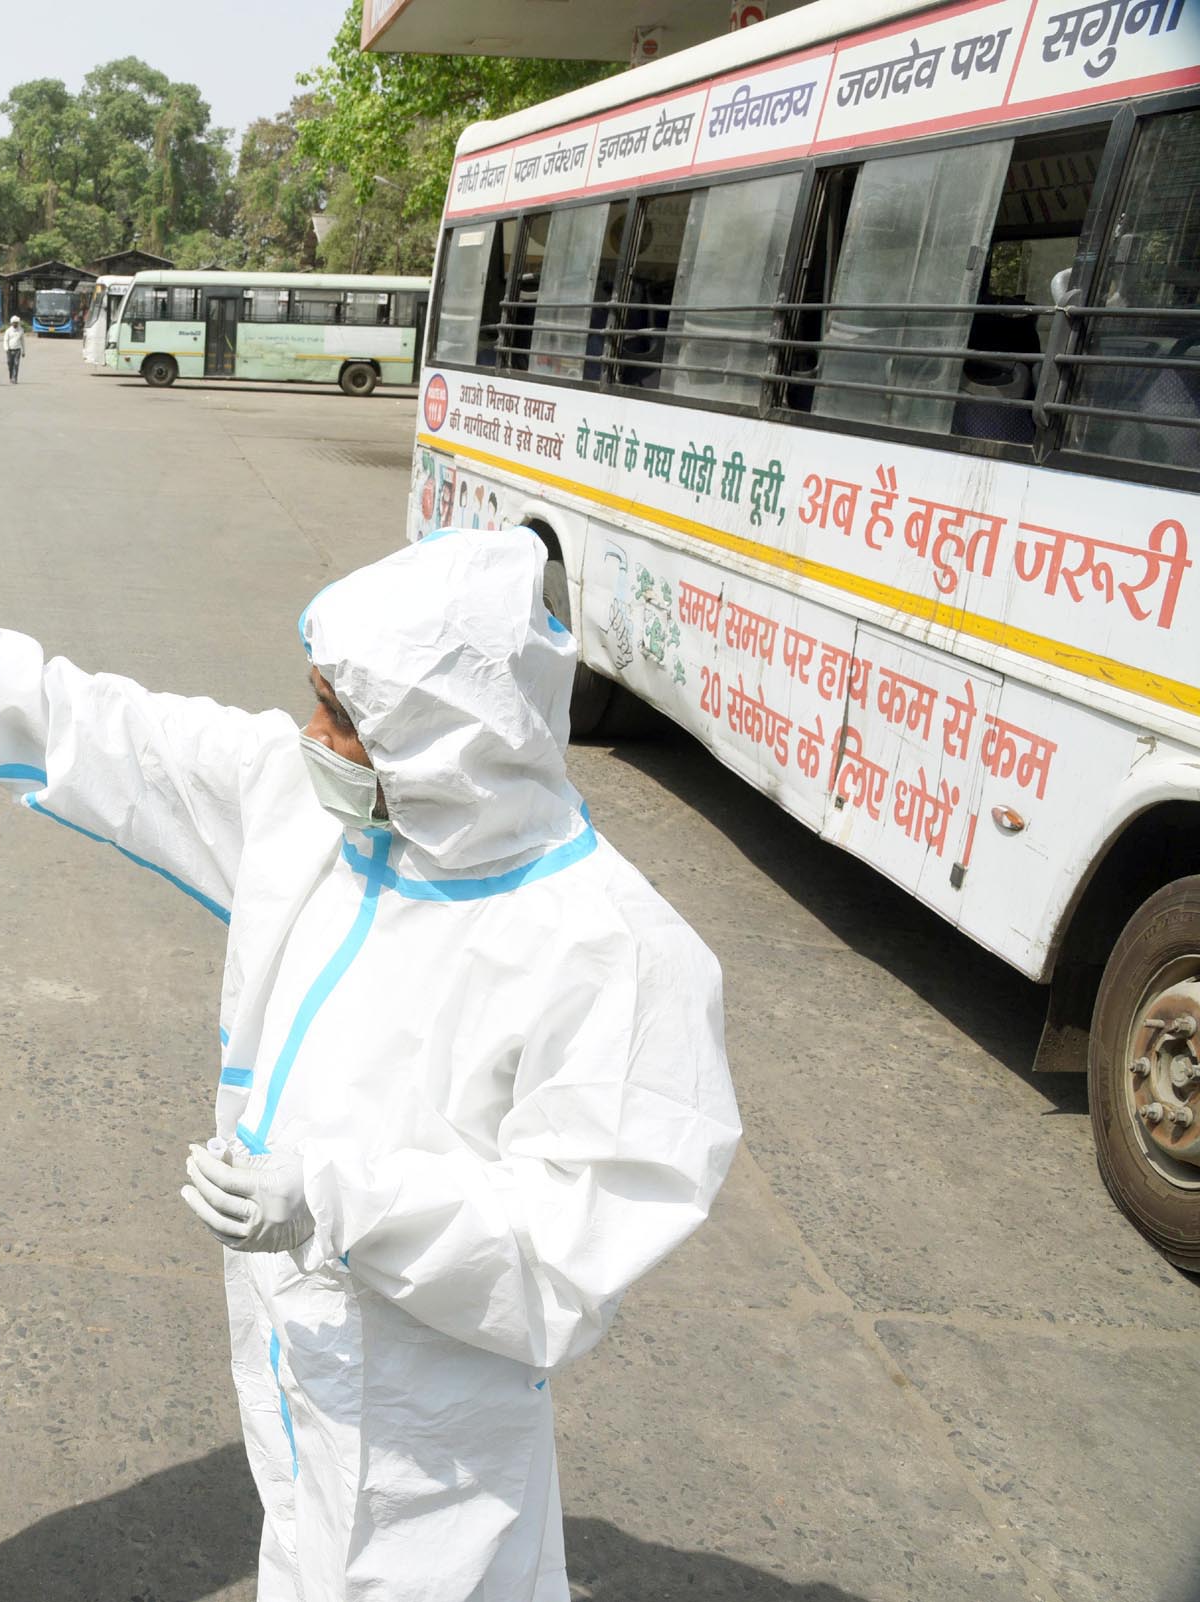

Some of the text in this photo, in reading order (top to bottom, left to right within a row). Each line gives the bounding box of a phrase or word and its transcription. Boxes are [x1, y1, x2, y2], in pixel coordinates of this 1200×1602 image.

[837, 27, 1011, 108] जगदेव पथ
[1043, 0, 1185, 78] सगुना
[597, 108, 696, 168] इनकम टैक्स
[707, 80, 817, 138] सचिवालय
[479, 160, 507, 190] मैदान
[514, 141, 589, 183] पटना जंक्शन
[450, 408, 461, 431] की
[504, 420, 513, 446] से
[516, 425, 533, 452] इसे
[536, 432, 565, 460] हरायें
[460, 382, 557, 423] आओ मिलकर समाज
[576, 418, 590, 459] दो
[593, 424, 623, 468] जनों
[624, 429, 640, 472] के
[721, 451, 746, 504] सी
[750, 459, 785, 527] दूरी,
[798, 464, 1192, 630] अब है बहुत जरूरी
[678, 580, 1058, 801] समय समय पर हाथ कम से कम
[700, 665, 721, 719] 20
[727, 672, 793, 767] सेकेण्ड
[797, 714, 824, 779] के
[828, 724, 889, 822] लिए
